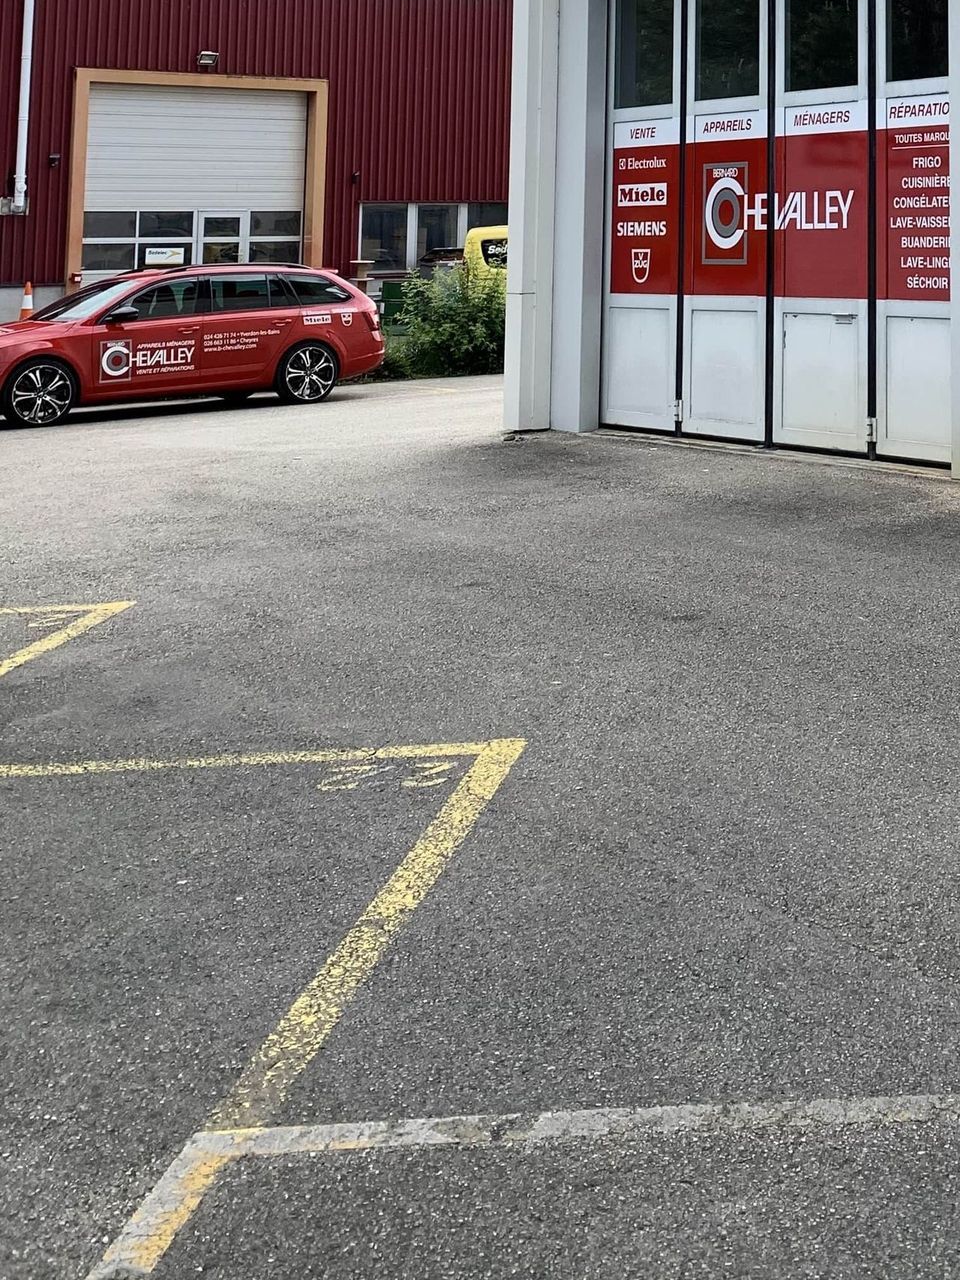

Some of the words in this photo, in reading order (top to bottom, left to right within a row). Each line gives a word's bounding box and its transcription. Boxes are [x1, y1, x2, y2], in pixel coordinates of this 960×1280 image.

[793, 110, 851, 127] MÉNAGERS
[703, 118, 752, 134] APPAREILS
[630, 127, 656, 140] VENTE
[894, 133, 923, 144] TOUTES
[627, 156, 667, 170] Electrolux
[912, 156, 942, 169] FRIGO
[712, 167, 738, 178] BERNARD
[620, 187, 665, 202] Miele
[893, 193, 951, 209] CONGÉLATE
[705, 177, 855, 250] CHEVALLEY
[617, 221, 667, 236] SIEMENS
[890, 216, 951, 229] LAVE-VAISSE
[634, 260, 648, 268] ZUG
[901, 256, 951, 268] LAVE-LING
[907, 274, 949, 289] SÉCHOIR
[102, 346, 195, 376] CHEVALLEY
